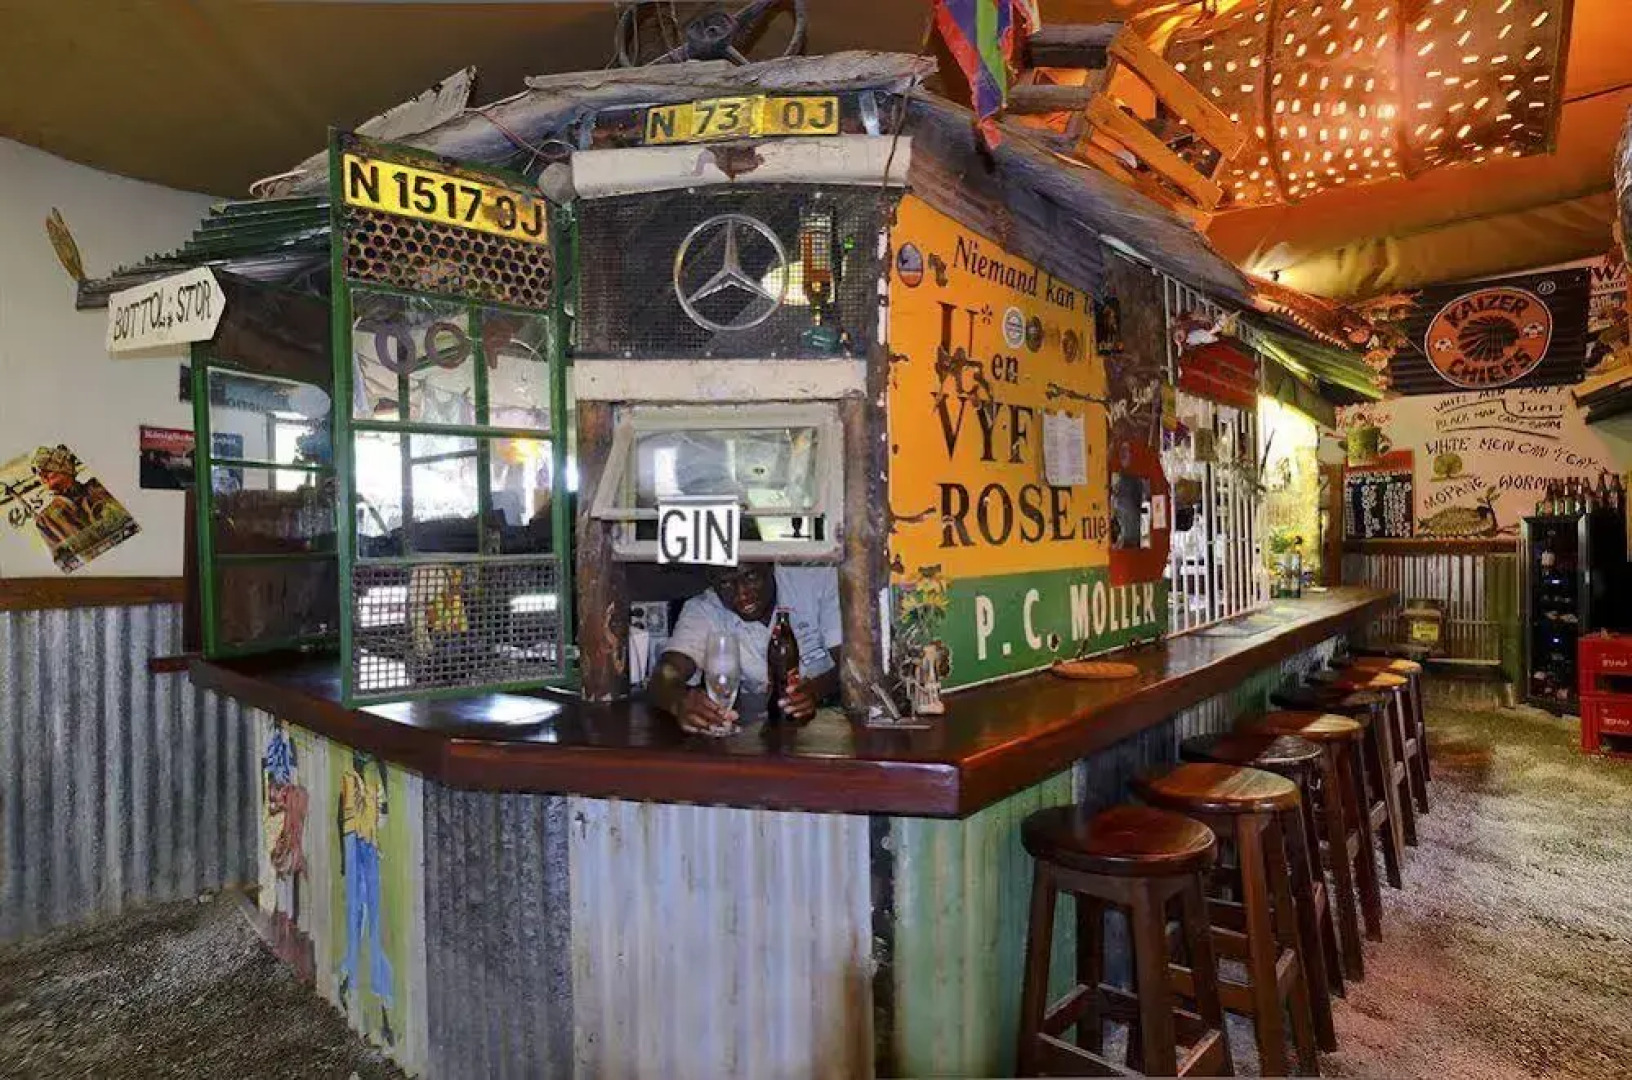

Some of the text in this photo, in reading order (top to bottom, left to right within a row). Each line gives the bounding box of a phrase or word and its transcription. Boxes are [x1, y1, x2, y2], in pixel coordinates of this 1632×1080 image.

[650, 110, 676, 138] N
[350, 161, 380, 203] N
[392, 171, 482, 222] 1517
[953, 236, 1038, 297] Niemand
[1046, 277, 1074, 310] kan
[176, 279, 211, 322] STOR
[1445, 294, 1530, 327] KAIZER
[991, 353, 1019, 383] en
[1448, 348, 1532, 384] CHIEFS
[931, 391, 1033, 464] VYF
[1426, 437, 1471, 455] WHITE
[661, 509, 733, 562] GIN
[938, 483, 1075, 548] ROSE
